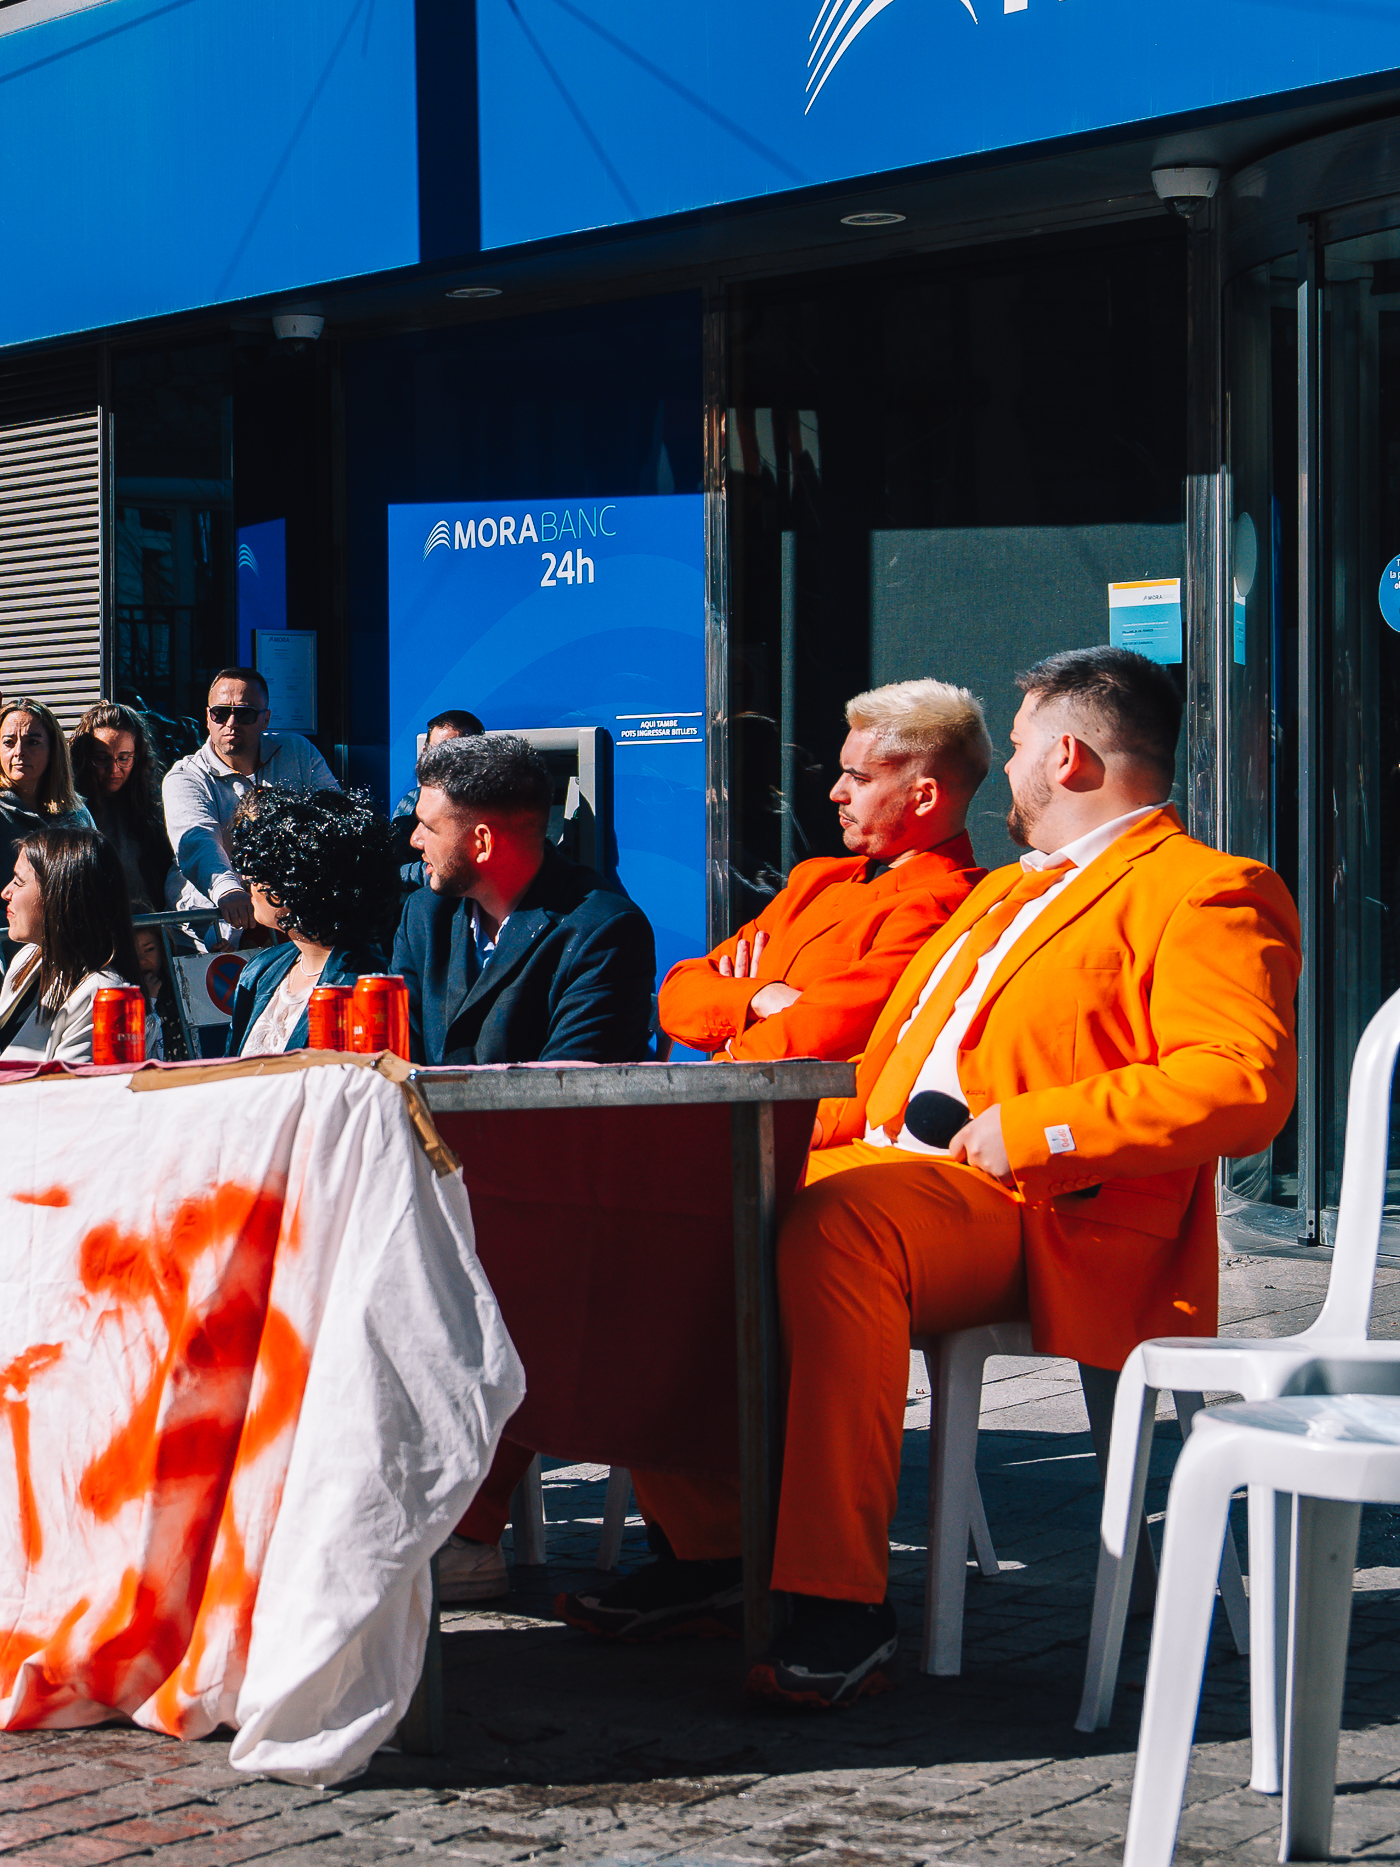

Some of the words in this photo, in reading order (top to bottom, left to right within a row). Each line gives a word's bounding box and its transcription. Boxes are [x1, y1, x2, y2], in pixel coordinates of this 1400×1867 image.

[540, 548, 595, 588] 24h
[621, 730, 637, 738] POTS
[637, 729, 671, 737] INGRESSAR
[671, 727, 698, 736] BITLLETS
